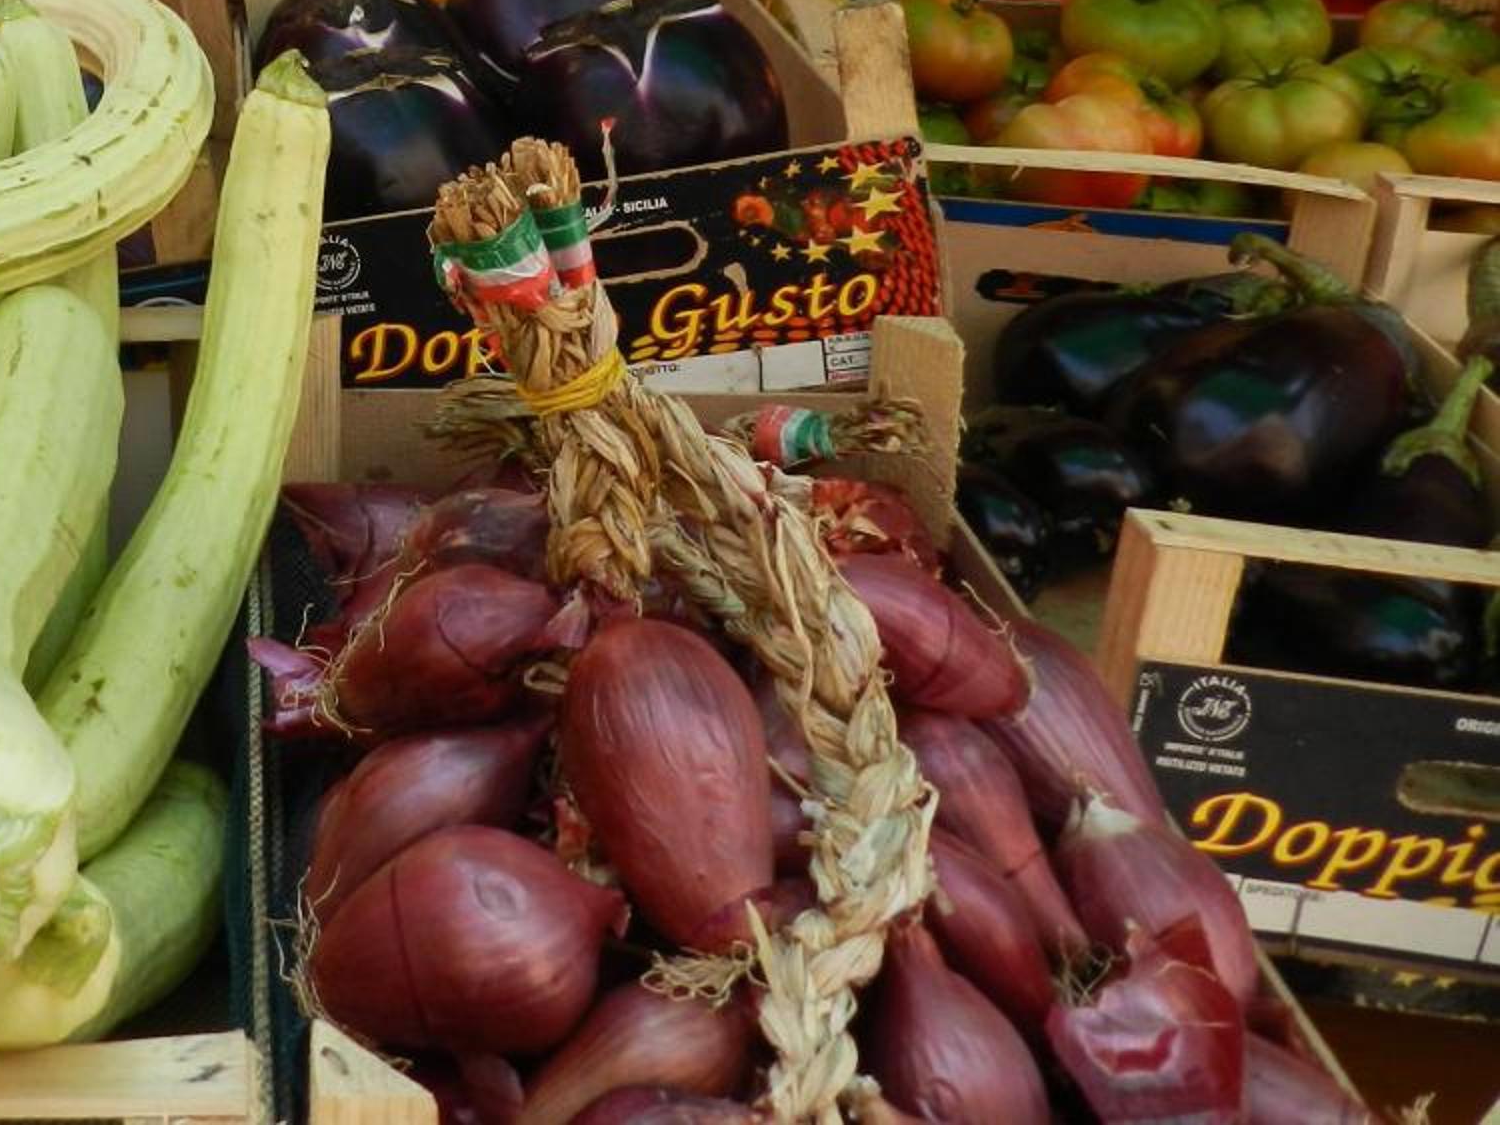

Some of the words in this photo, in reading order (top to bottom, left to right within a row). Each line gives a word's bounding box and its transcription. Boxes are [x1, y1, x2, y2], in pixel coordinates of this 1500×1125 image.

[623, 196, 669, 214] SICILIA
[652, 272, 878, 356] Gusto
[1192, 675, 1247, 696] ITALIA
